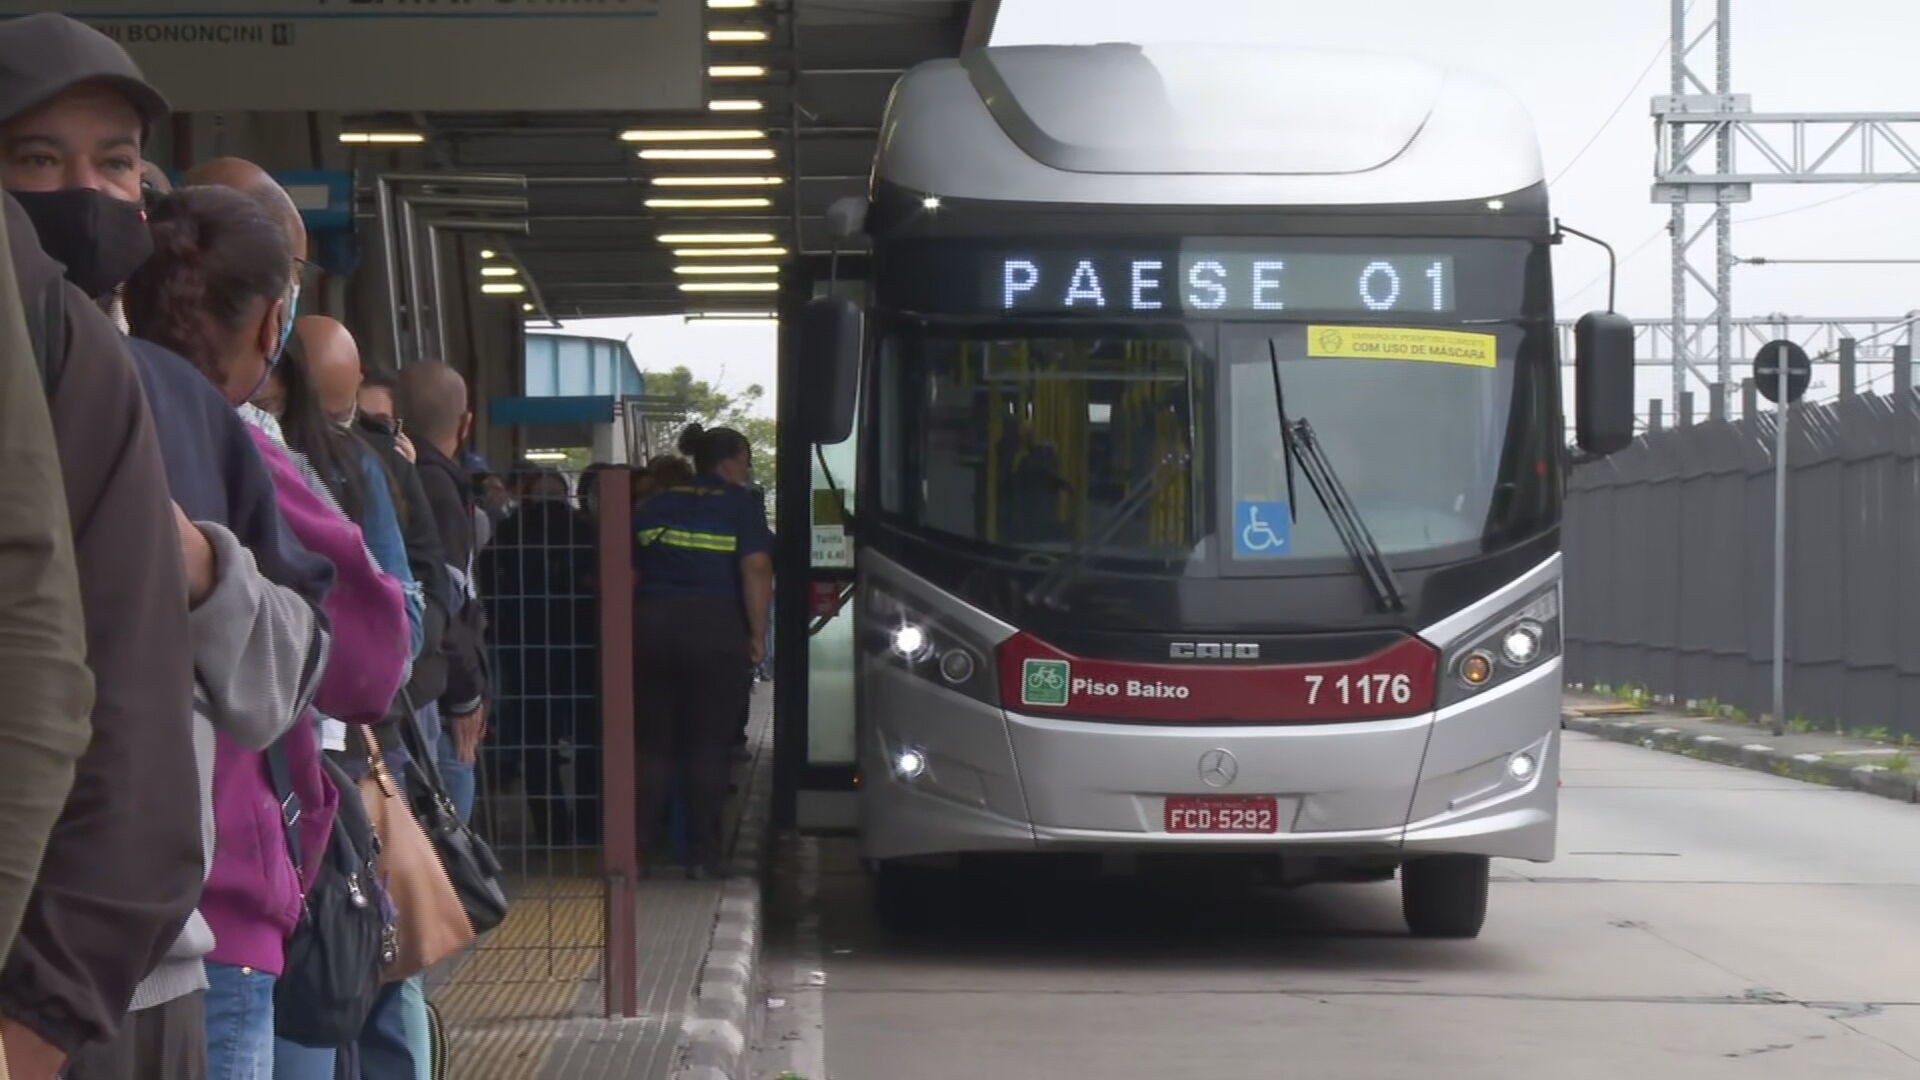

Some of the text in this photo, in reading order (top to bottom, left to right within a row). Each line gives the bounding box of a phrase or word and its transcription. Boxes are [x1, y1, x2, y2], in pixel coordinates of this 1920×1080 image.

[1003, 260, 1443, 310] PAESE 01
[1352, 342, 1380, 352] COM
[1383, 343, 1408, 354] USO
[1411, 344, 1427, 355] DE
[1170, 642, 1259, 658] CAIO
[1072, 678, 1119, 696] Piso
[1127, 680, 1189, 699] Baixo
[1336, 674, 1411, 704] 1176
